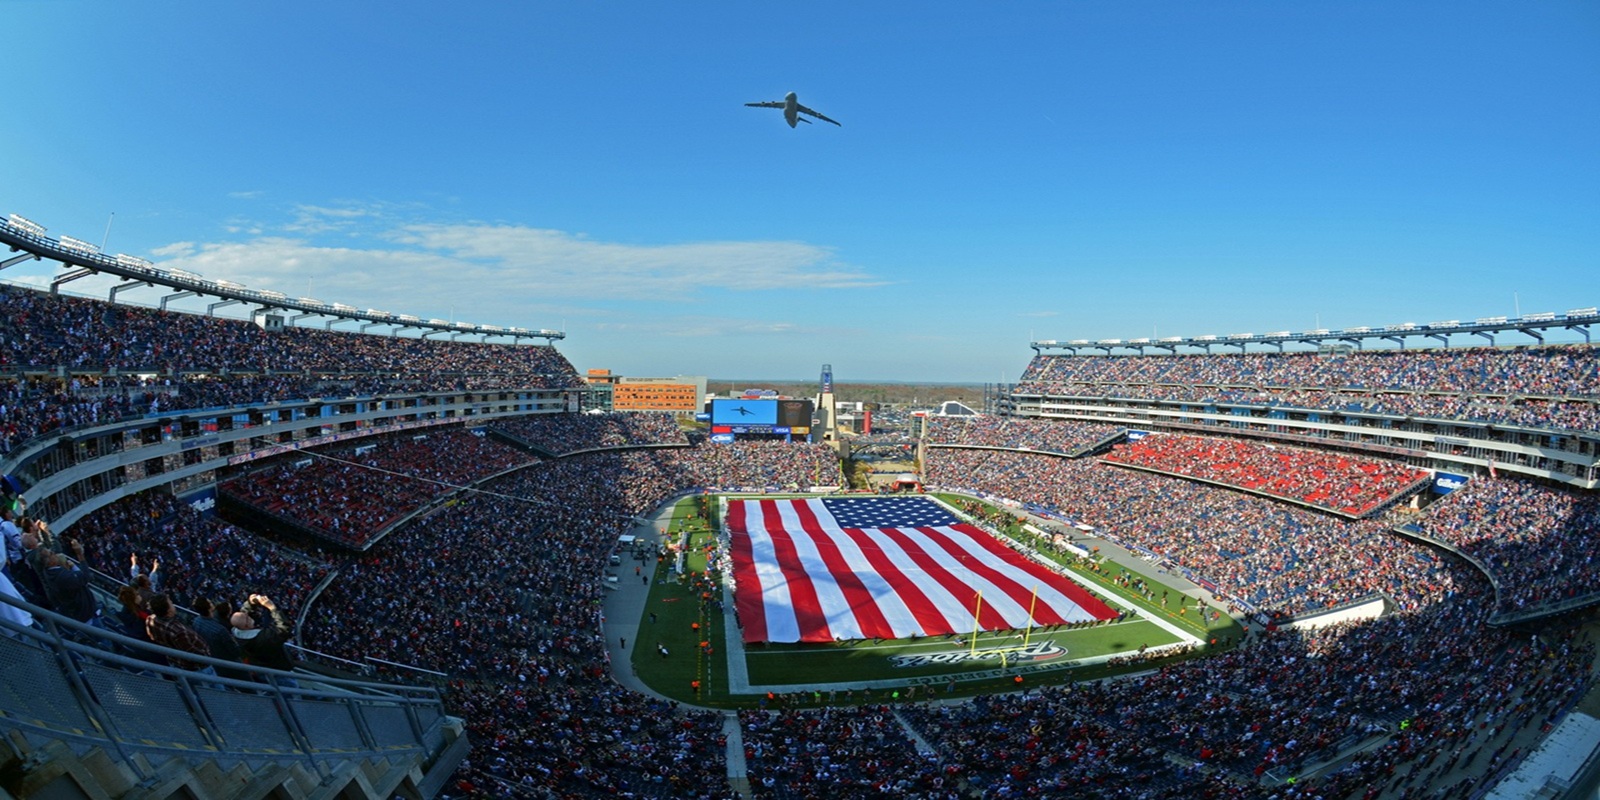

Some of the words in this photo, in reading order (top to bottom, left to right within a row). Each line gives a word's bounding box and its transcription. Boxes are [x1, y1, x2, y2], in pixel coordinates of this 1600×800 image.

[1436, 478, 1462, 489] Gillett
[909, 671, 988, 685] SERVICE
[992, 668, 1016, 677] TO
